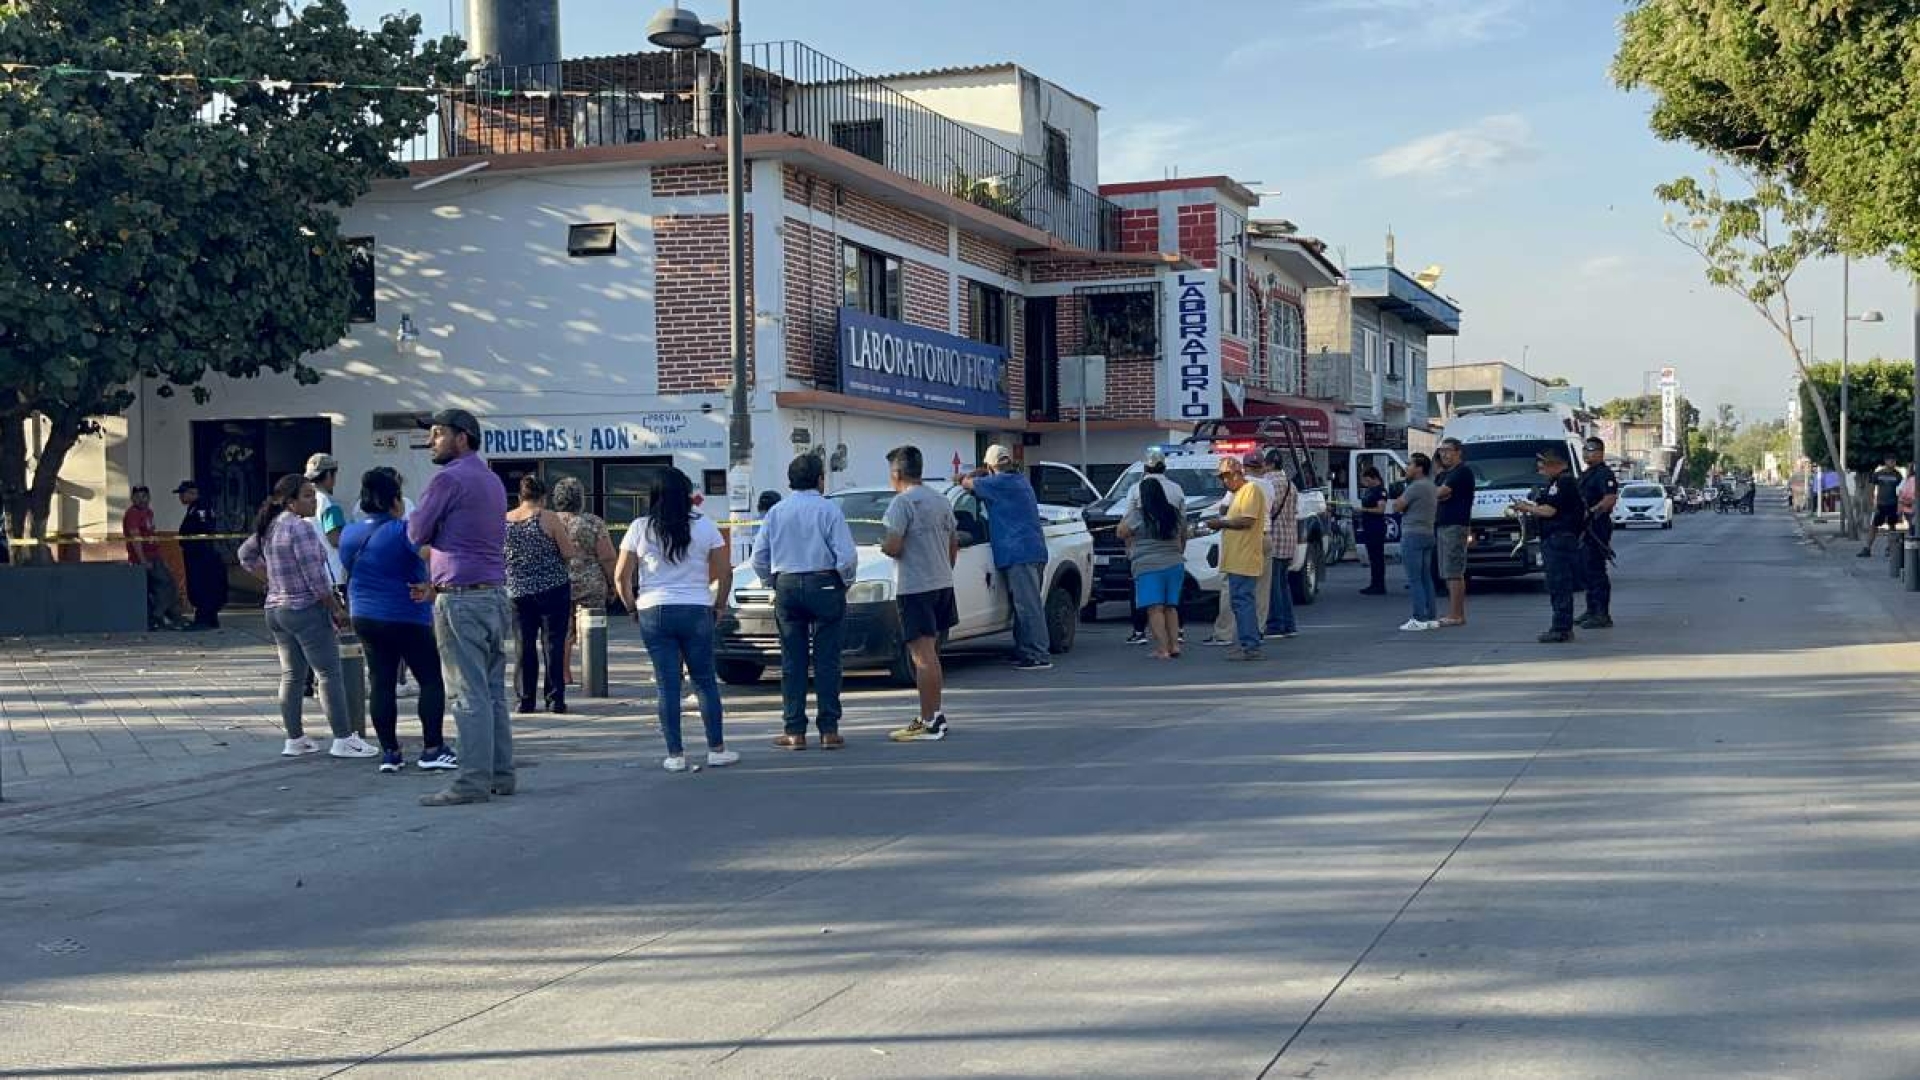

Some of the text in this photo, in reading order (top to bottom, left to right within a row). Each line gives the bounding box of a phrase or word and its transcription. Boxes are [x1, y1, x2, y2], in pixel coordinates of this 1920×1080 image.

[848, 325, 962, 387] LABORATORIO
[1178, 274, 1209, 417] LABORATORIO
[484, 427, 569, 454] PRUEBAS
[590, 426, 630, 451] ADN
